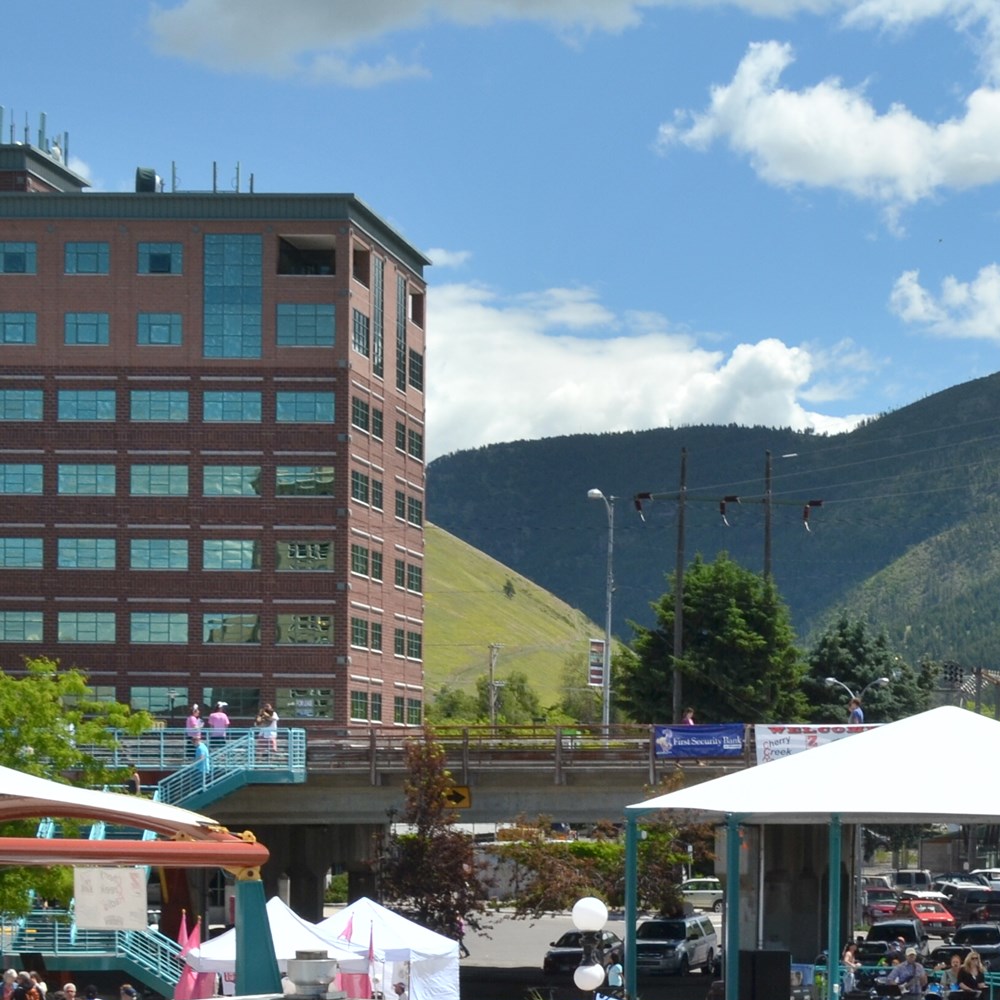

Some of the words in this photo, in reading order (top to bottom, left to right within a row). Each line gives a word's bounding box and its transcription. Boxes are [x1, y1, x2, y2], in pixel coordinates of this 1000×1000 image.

[673, 737, 690, 746] First
[691, 736, 721, 747] Security
[722, 736, 742, 744] Bank
[763, 736, 791, 750] Cherry
[763, 747, 792, 757] Creek
